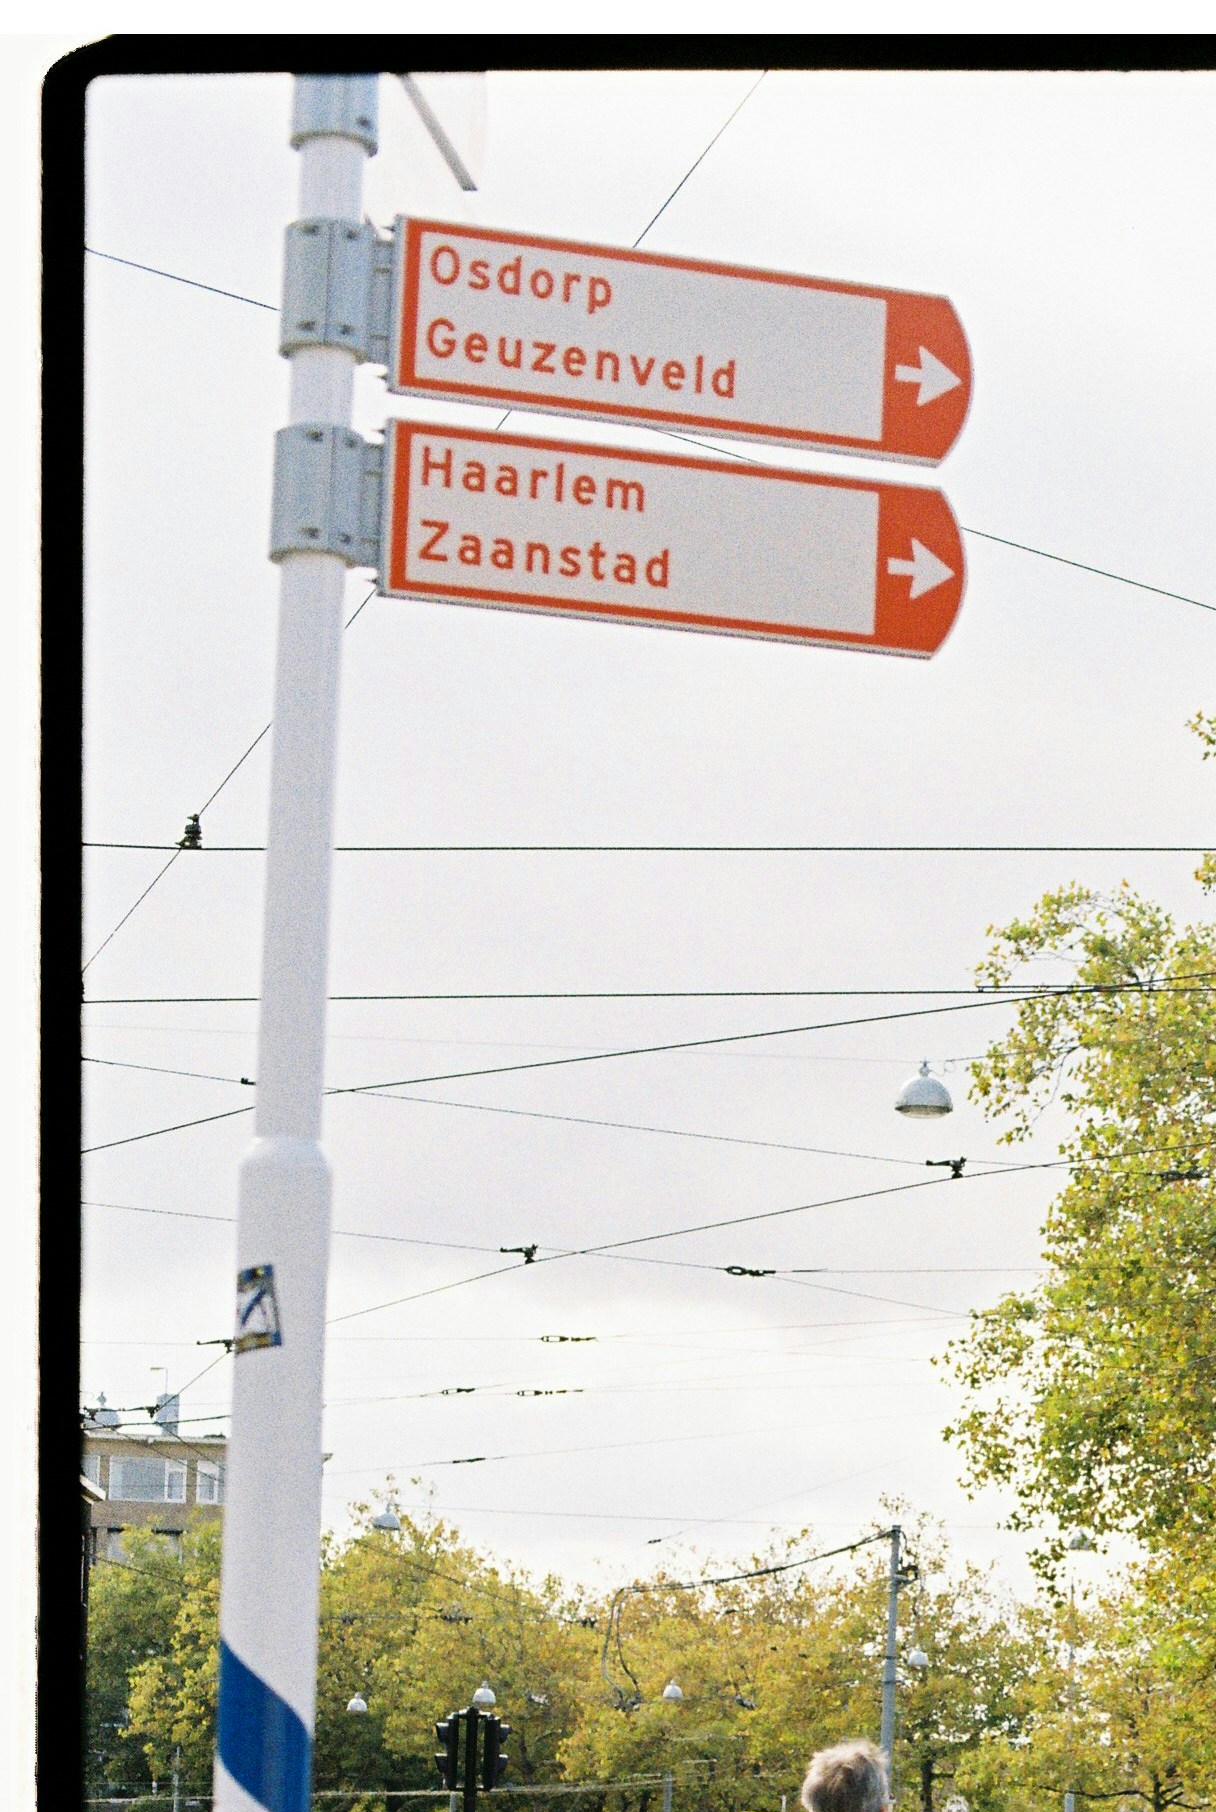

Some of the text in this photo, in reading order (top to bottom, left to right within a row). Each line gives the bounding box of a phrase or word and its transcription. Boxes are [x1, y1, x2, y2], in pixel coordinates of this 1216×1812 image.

[429, 244, 614, 314] Osdorp
[425, 318, 737, 400] Geuzenveld
[420, 446, 646, 514] Haarlem
[418, 519, 670, 590] Zaanstad
